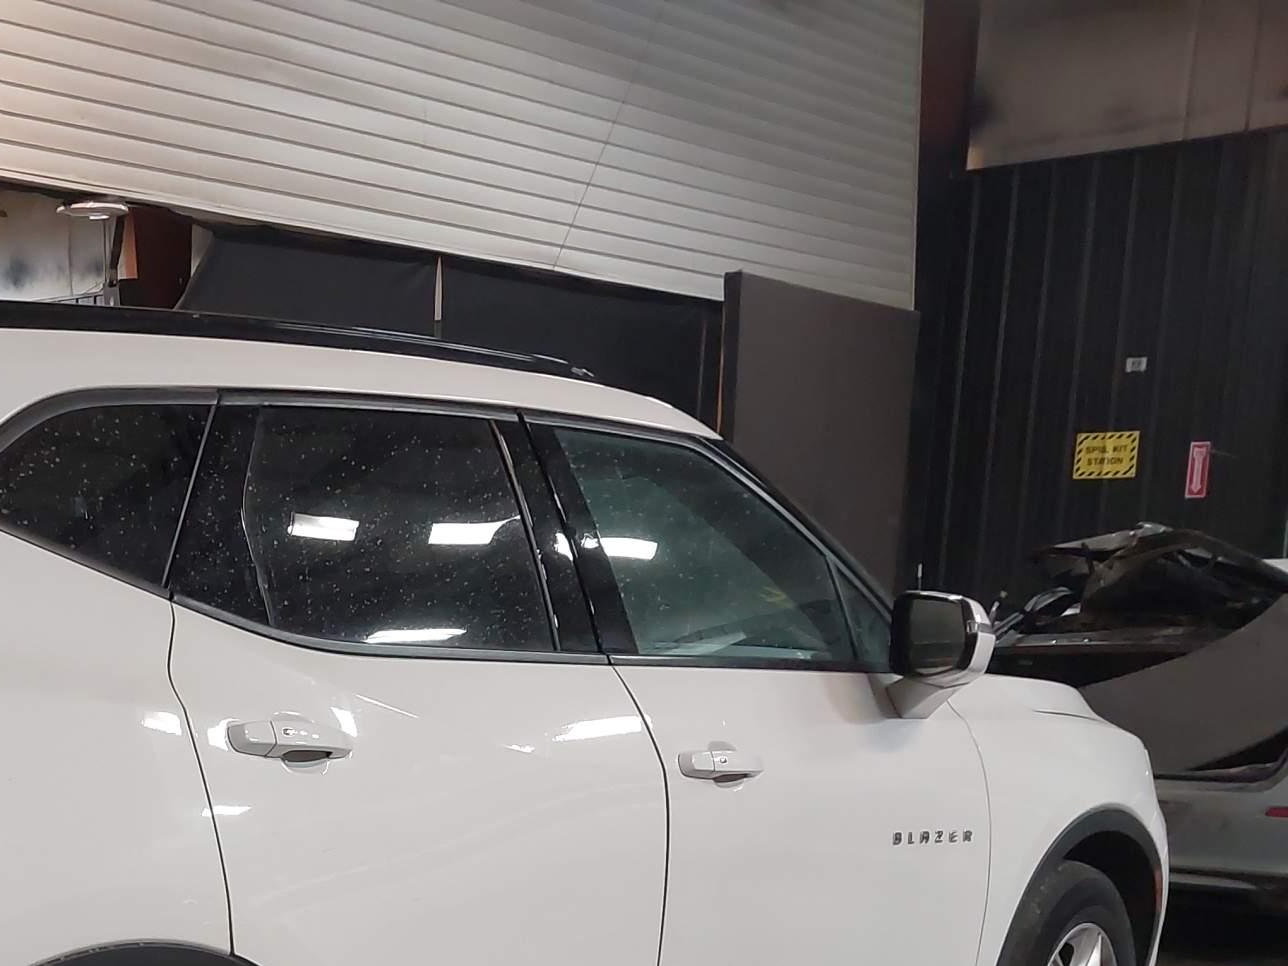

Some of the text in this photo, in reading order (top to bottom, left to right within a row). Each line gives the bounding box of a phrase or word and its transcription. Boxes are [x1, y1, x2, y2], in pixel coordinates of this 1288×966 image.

[1113, 444, 1128, 453] KIT
[1087, 456, 1123, 466] STATION
[892, 830, 973, 845] BLAZER
